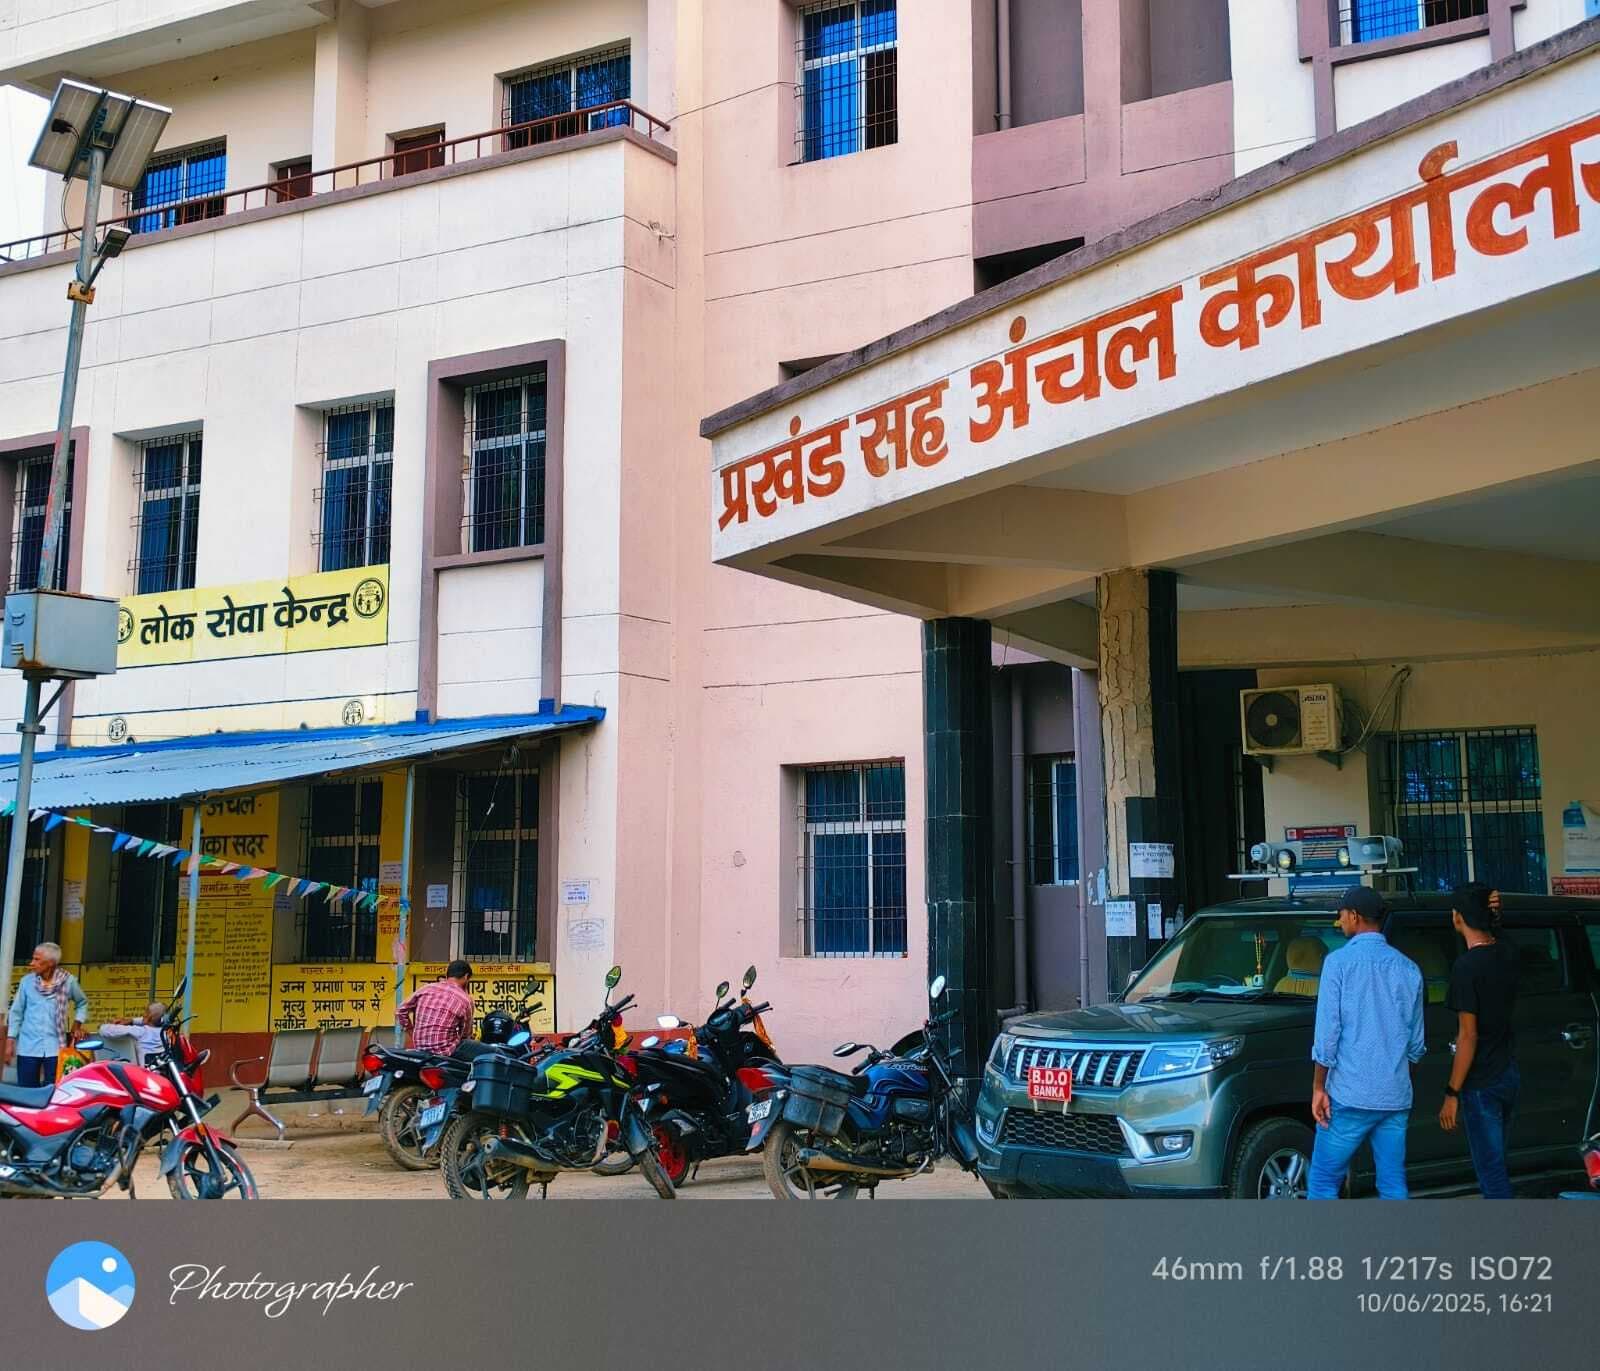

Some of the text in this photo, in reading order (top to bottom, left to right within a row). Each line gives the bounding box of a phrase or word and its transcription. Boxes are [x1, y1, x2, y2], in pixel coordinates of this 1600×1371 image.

[718, 116, 1600, 531] प्रखंड सह अंचल कार्याल
[140, 587, 351, 645] लोक सेवा केन्द्र
[232, 834, 269, 858] सदर
[280, 975, 388, 994] जन्म प्रमाण पत्र एवं
[281, 993, 381, 1017] मृत्यु प्रमाण पत्र से
[474, 995, 487, 1012] से
[1032, 1070, 1068, 1086] B.D.O
[1034, 1085, 1065, 1098] BANKA
